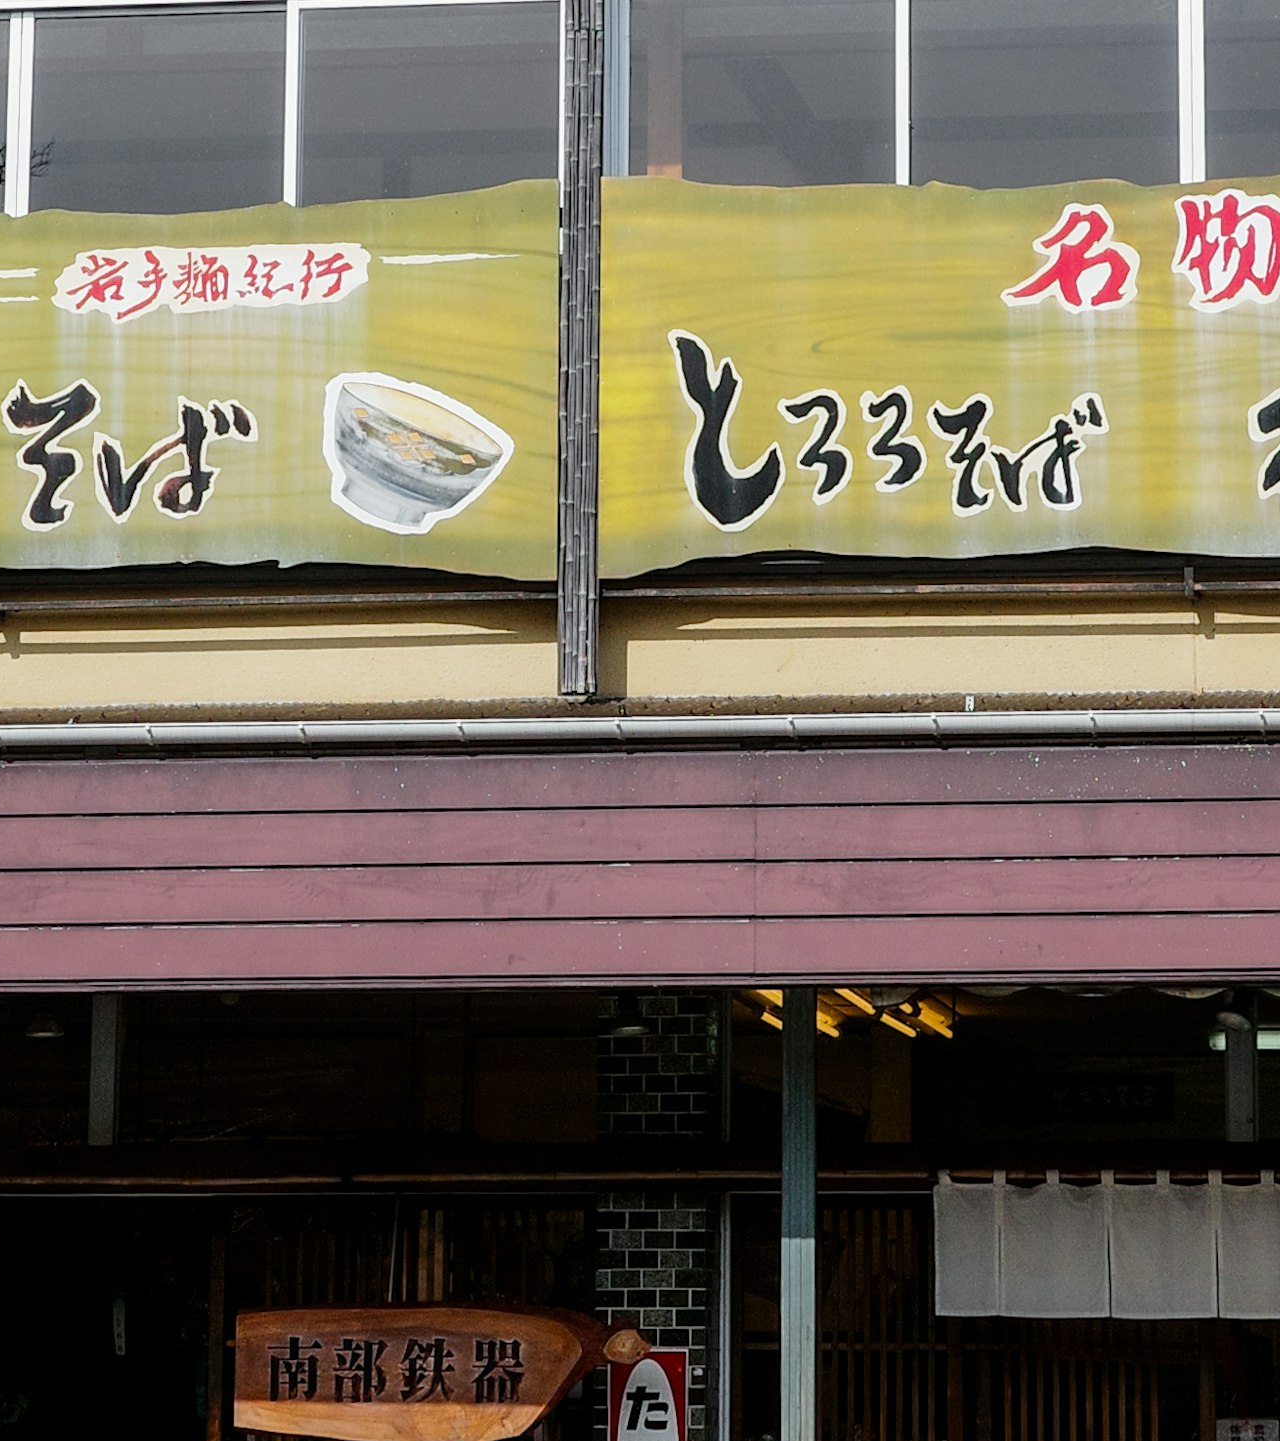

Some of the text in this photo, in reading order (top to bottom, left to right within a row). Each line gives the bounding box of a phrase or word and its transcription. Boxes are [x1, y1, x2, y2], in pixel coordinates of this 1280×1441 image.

[673, 332, 1103, 524] とろろそば
[267, 1336, 525, 1403] 南部鉄器
